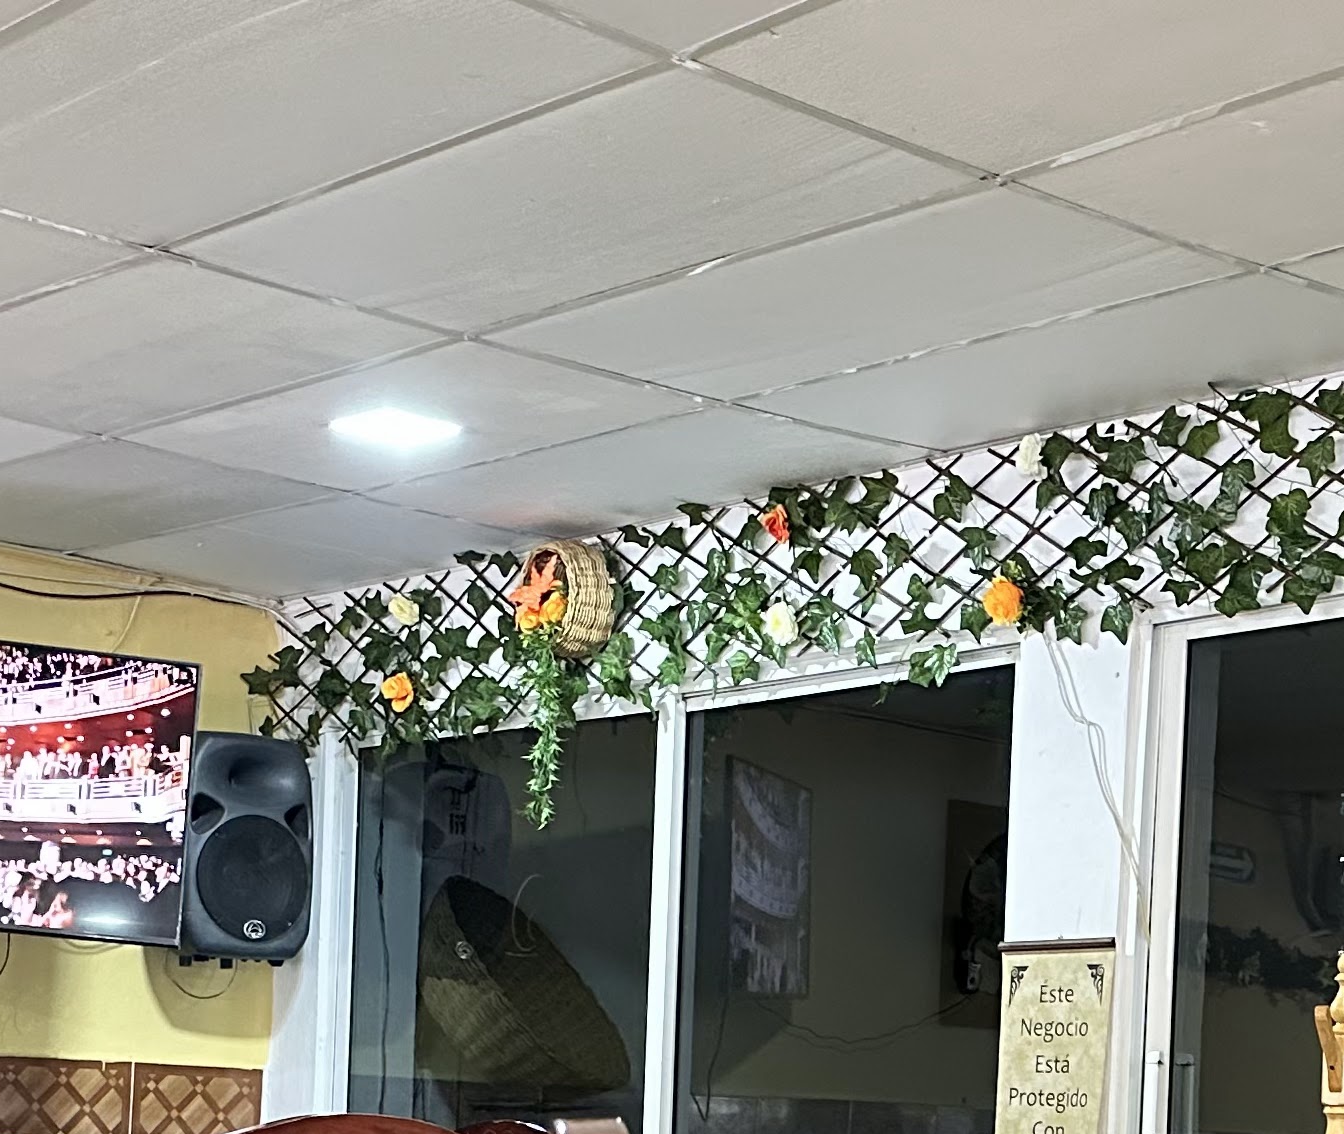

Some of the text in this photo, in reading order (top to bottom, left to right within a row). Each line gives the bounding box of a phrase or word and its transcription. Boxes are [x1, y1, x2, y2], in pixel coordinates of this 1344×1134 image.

[1021, 1018, 1089, 1043] Negocio
[1035, 1053, 1070, 1074] Está
[1009, 1087, 1088, 1114] Protegido
